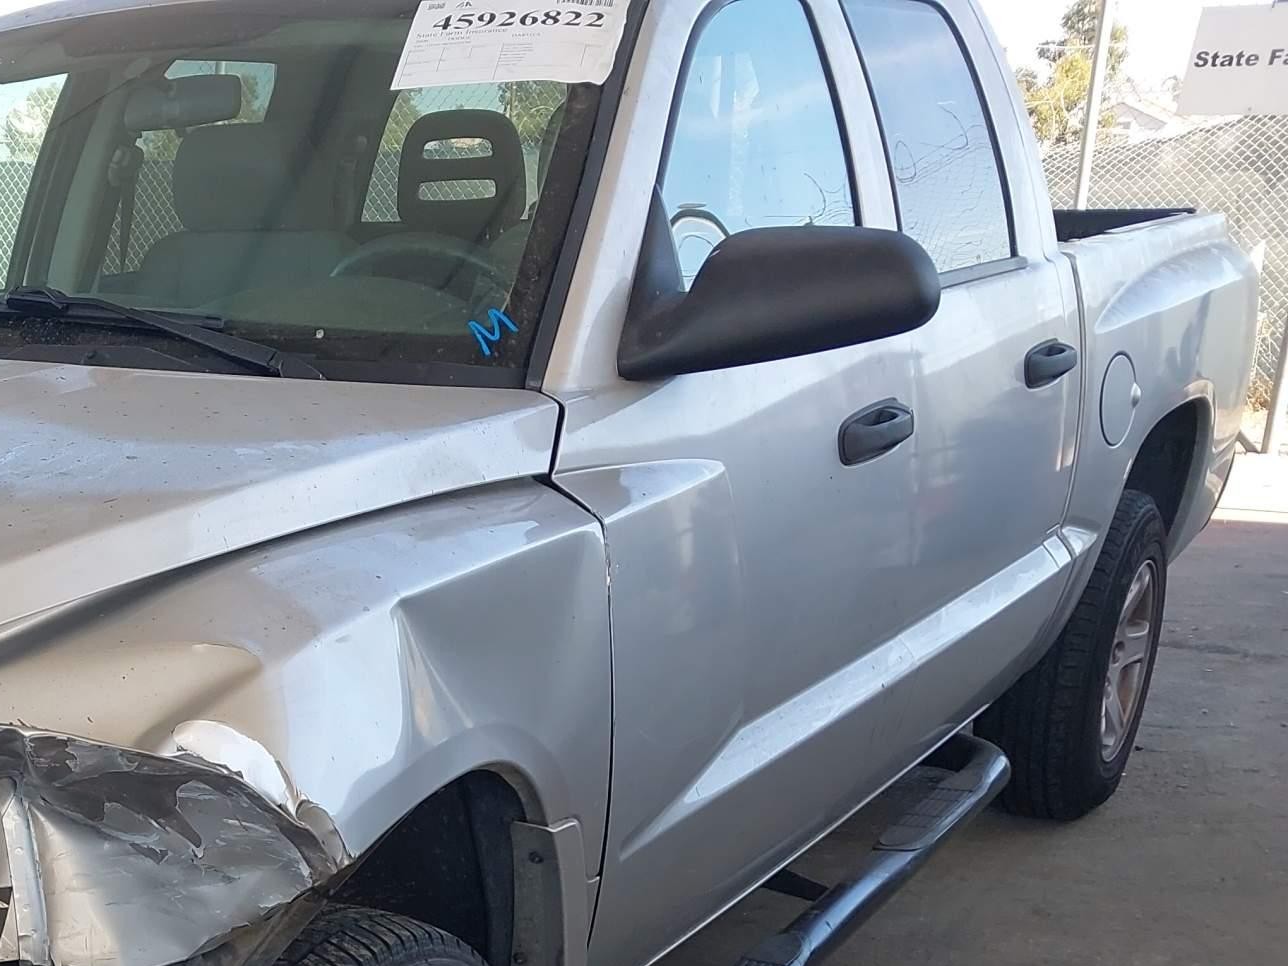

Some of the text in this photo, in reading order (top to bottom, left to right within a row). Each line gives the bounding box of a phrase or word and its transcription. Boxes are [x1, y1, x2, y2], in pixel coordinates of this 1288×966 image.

[432, 10, 605, 30] 45926822
[1194, 50, 1259, 68] State
[467, 308, 520, 356] M
